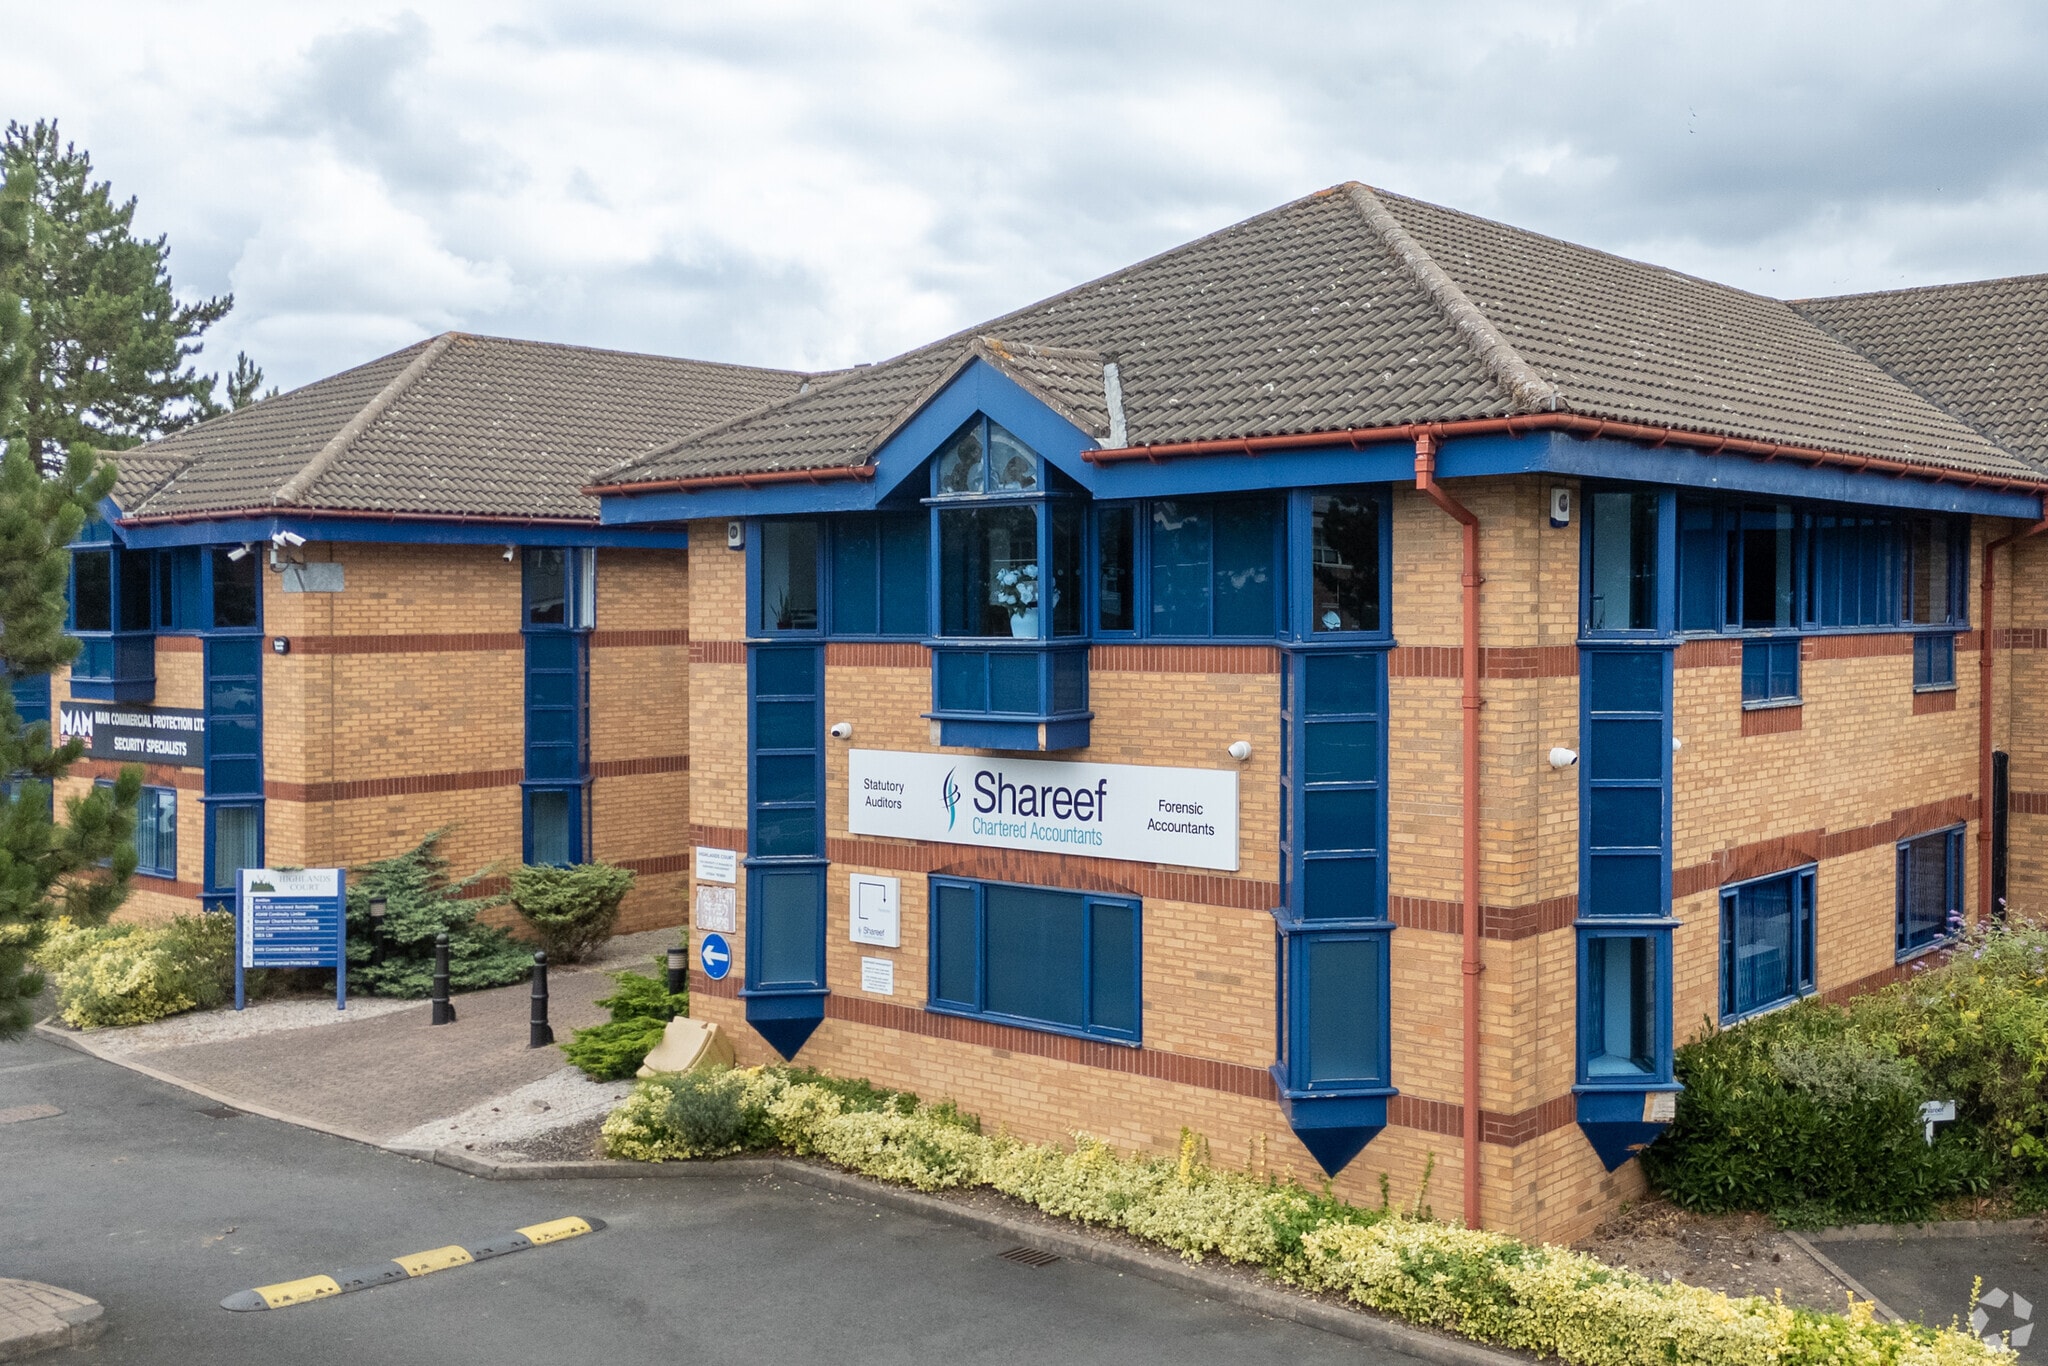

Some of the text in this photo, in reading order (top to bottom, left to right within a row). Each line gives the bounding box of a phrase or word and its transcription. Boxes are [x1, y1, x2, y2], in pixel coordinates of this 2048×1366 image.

[95, 711, 111, 725] MAN
[111, 712, 152, 727] COMMERCIAL
[153, 715, 193, 731] PROTECTION
[114, 736, 188, 756] SECURITY SPECIALISTS
[863, 777, 905, 796] Statutory
[865, 796, 902, 810] Auditors
[973, 770, 1107, 822] Shareef
[1158, 799, 1204, 816] Forensic
[972, 817, 1103, 846] Chartered Accountants
[1147, 818, 1215, 836] Accountants
[279, 875, 331, 883] HIGHLANDS
[290, 883, 320, 891] COURT
